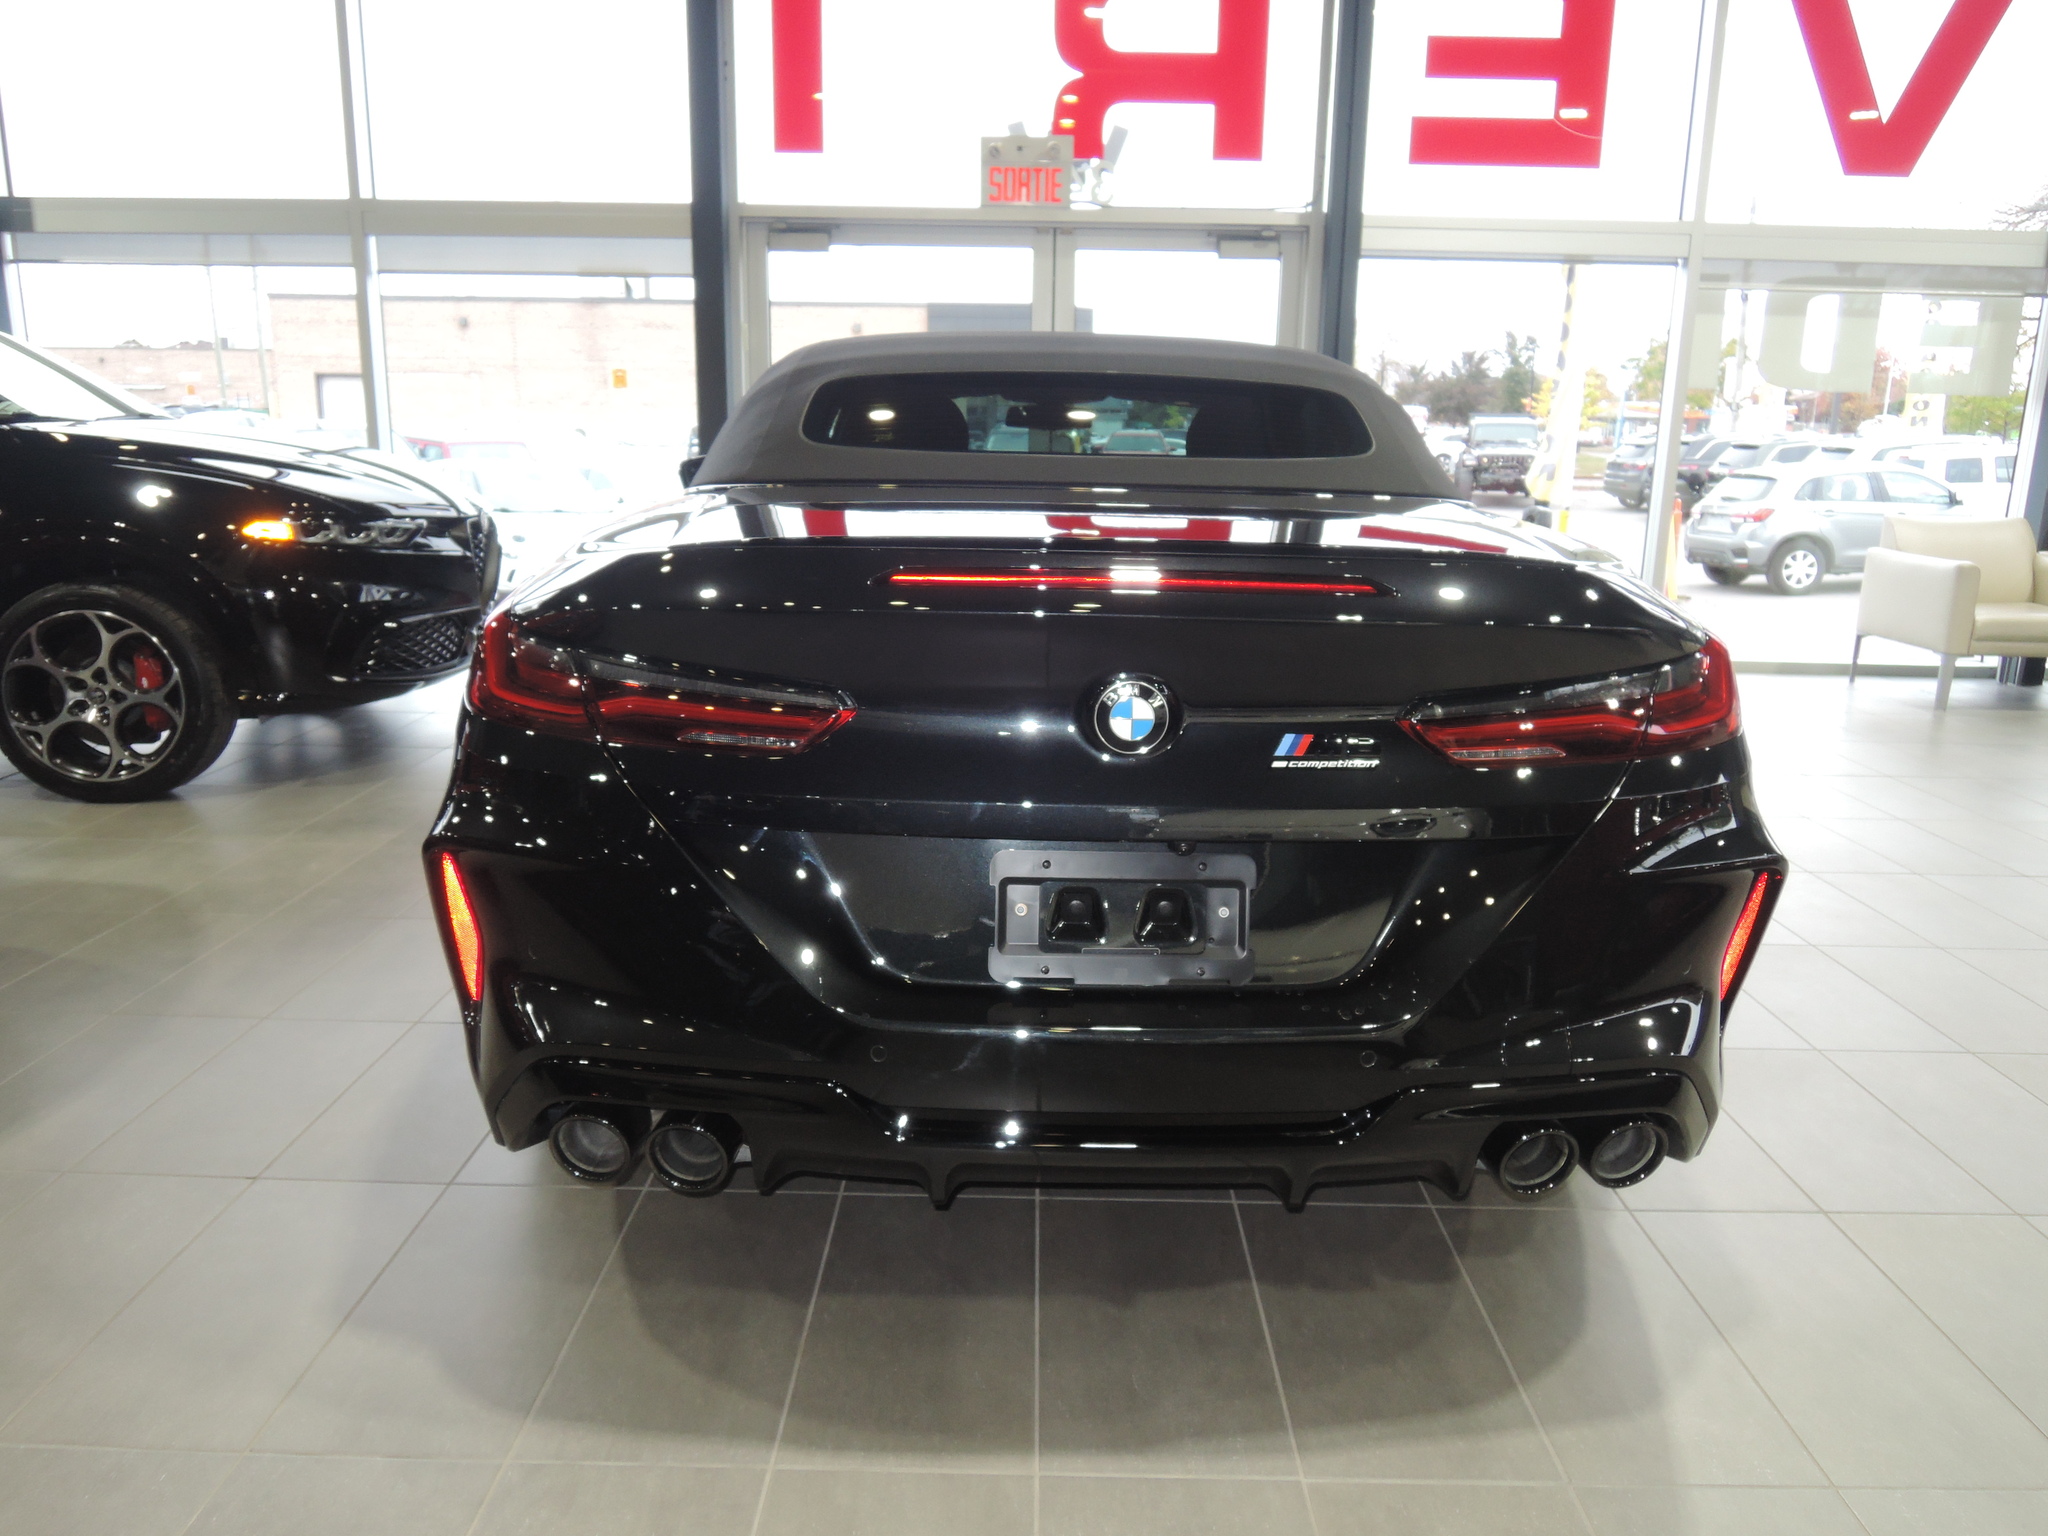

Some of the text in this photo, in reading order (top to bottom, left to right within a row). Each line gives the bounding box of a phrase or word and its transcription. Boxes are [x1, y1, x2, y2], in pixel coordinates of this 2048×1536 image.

[987, 166, 1064, 204] SORTIE
[1102, 684, 1164, 708] BMW
[1287, 758, 1381, 770] competition
